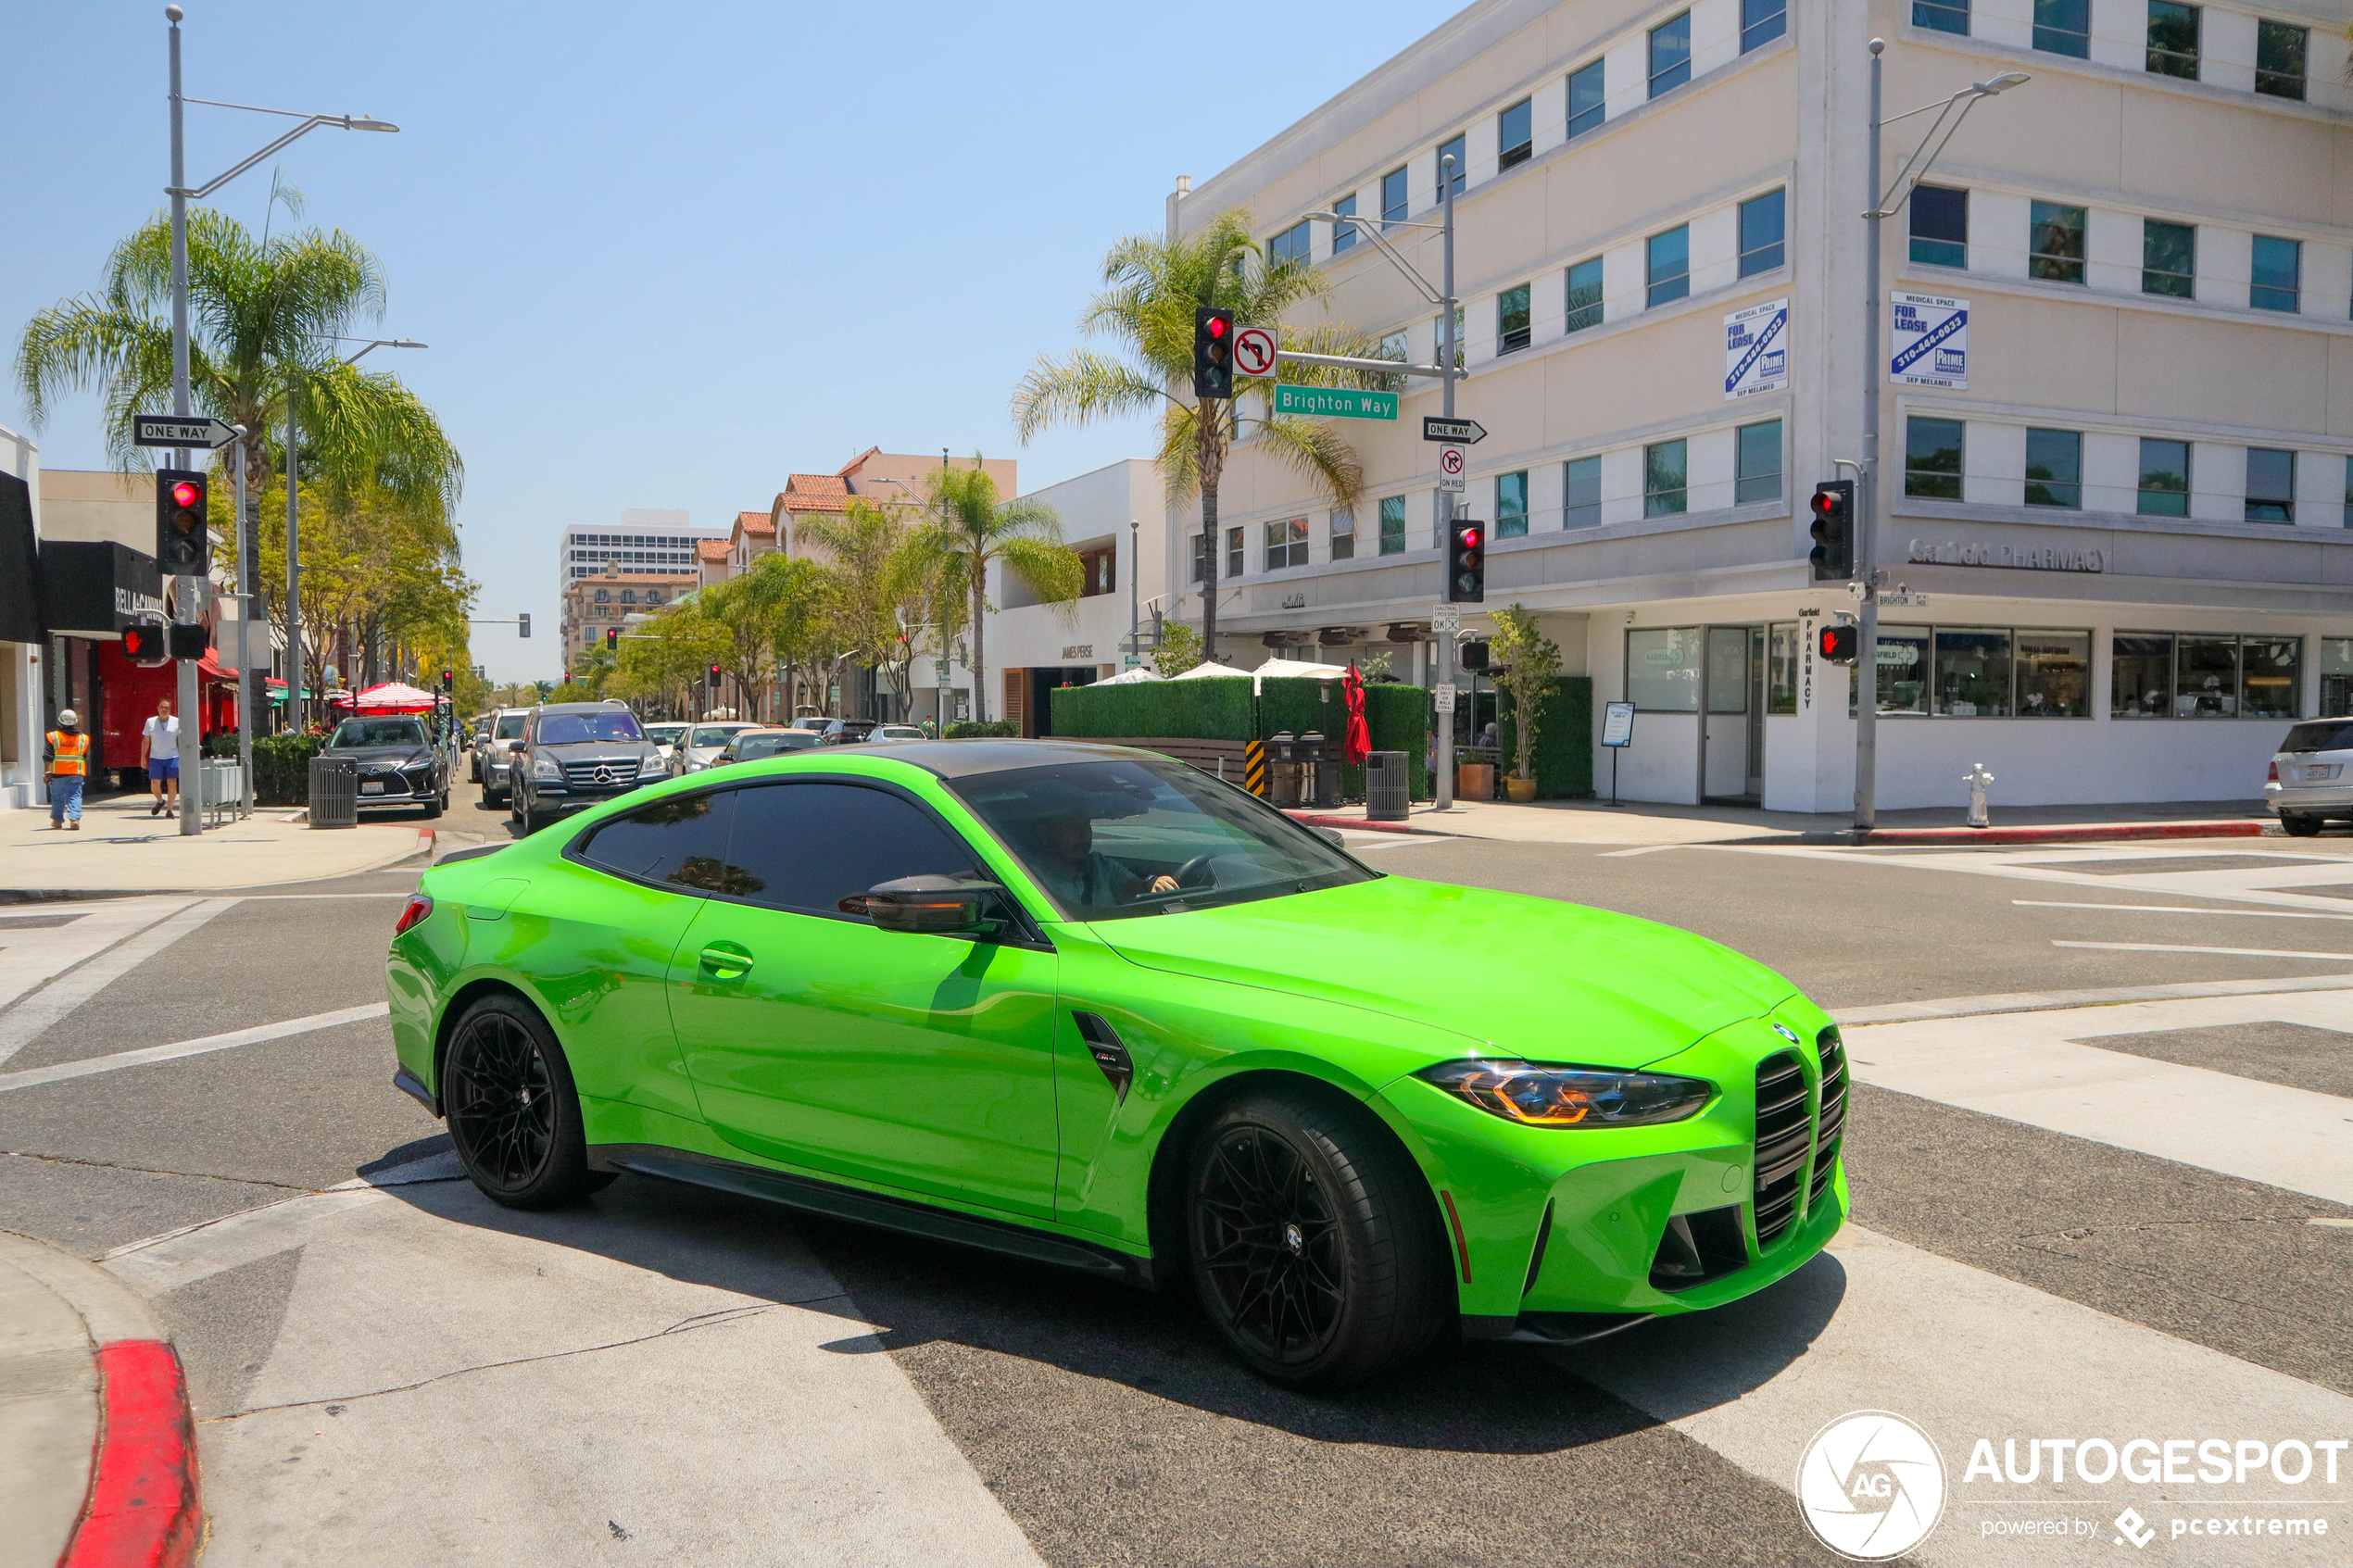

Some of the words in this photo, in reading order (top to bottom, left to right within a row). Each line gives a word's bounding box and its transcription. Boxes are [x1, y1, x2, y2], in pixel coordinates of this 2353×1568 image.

[1906, 295, 1933, 305] MEDICAL
[1735, 308, 1757, 320] MEDICAL
[1759, 303, 1776, 314] SPACE
[1894, 305, 1917, 319] FOR
[1728, 323, 1744, 338] FOR
[1894, 318, 1928, 333] LEASE
[1728, 332, 1755, 351] LEASE
[1897, 317, 1962, 367] 310-444-0033
[1730, 317, 1782, 384] 310-444-0033
[1761, 354, 1784, 370] PRIME
[1936, 349, 1964, 367] PRIME
[1920, 378, 1953, 387] MELAMED
[1737, 389, 1747, 397] SEP
[1748, 383, 1775, 395] MELAMED
[1283, 392, 1353, 414] Brighton
[1361, 397, 1391, 417] Way
[145, 425, 174, 437] ONE
[180, 427, 208, 438] WAY
[1430, 424, 1448, 434] ONE
[1452, 427, 1469, 436] WAY
[1442, 479, 1450, 487] ON
[2000, 544, 2113, 571] PHARMACY
[1880, 596, 1908, 605] BRIGHTON
[1799, 608, 1819, 617] Garfield
[1434, 620, 1444, 630] OK
[1062, 646, 1076, 659] JAMES
[1077, 645, 1093, 659] PERSE
